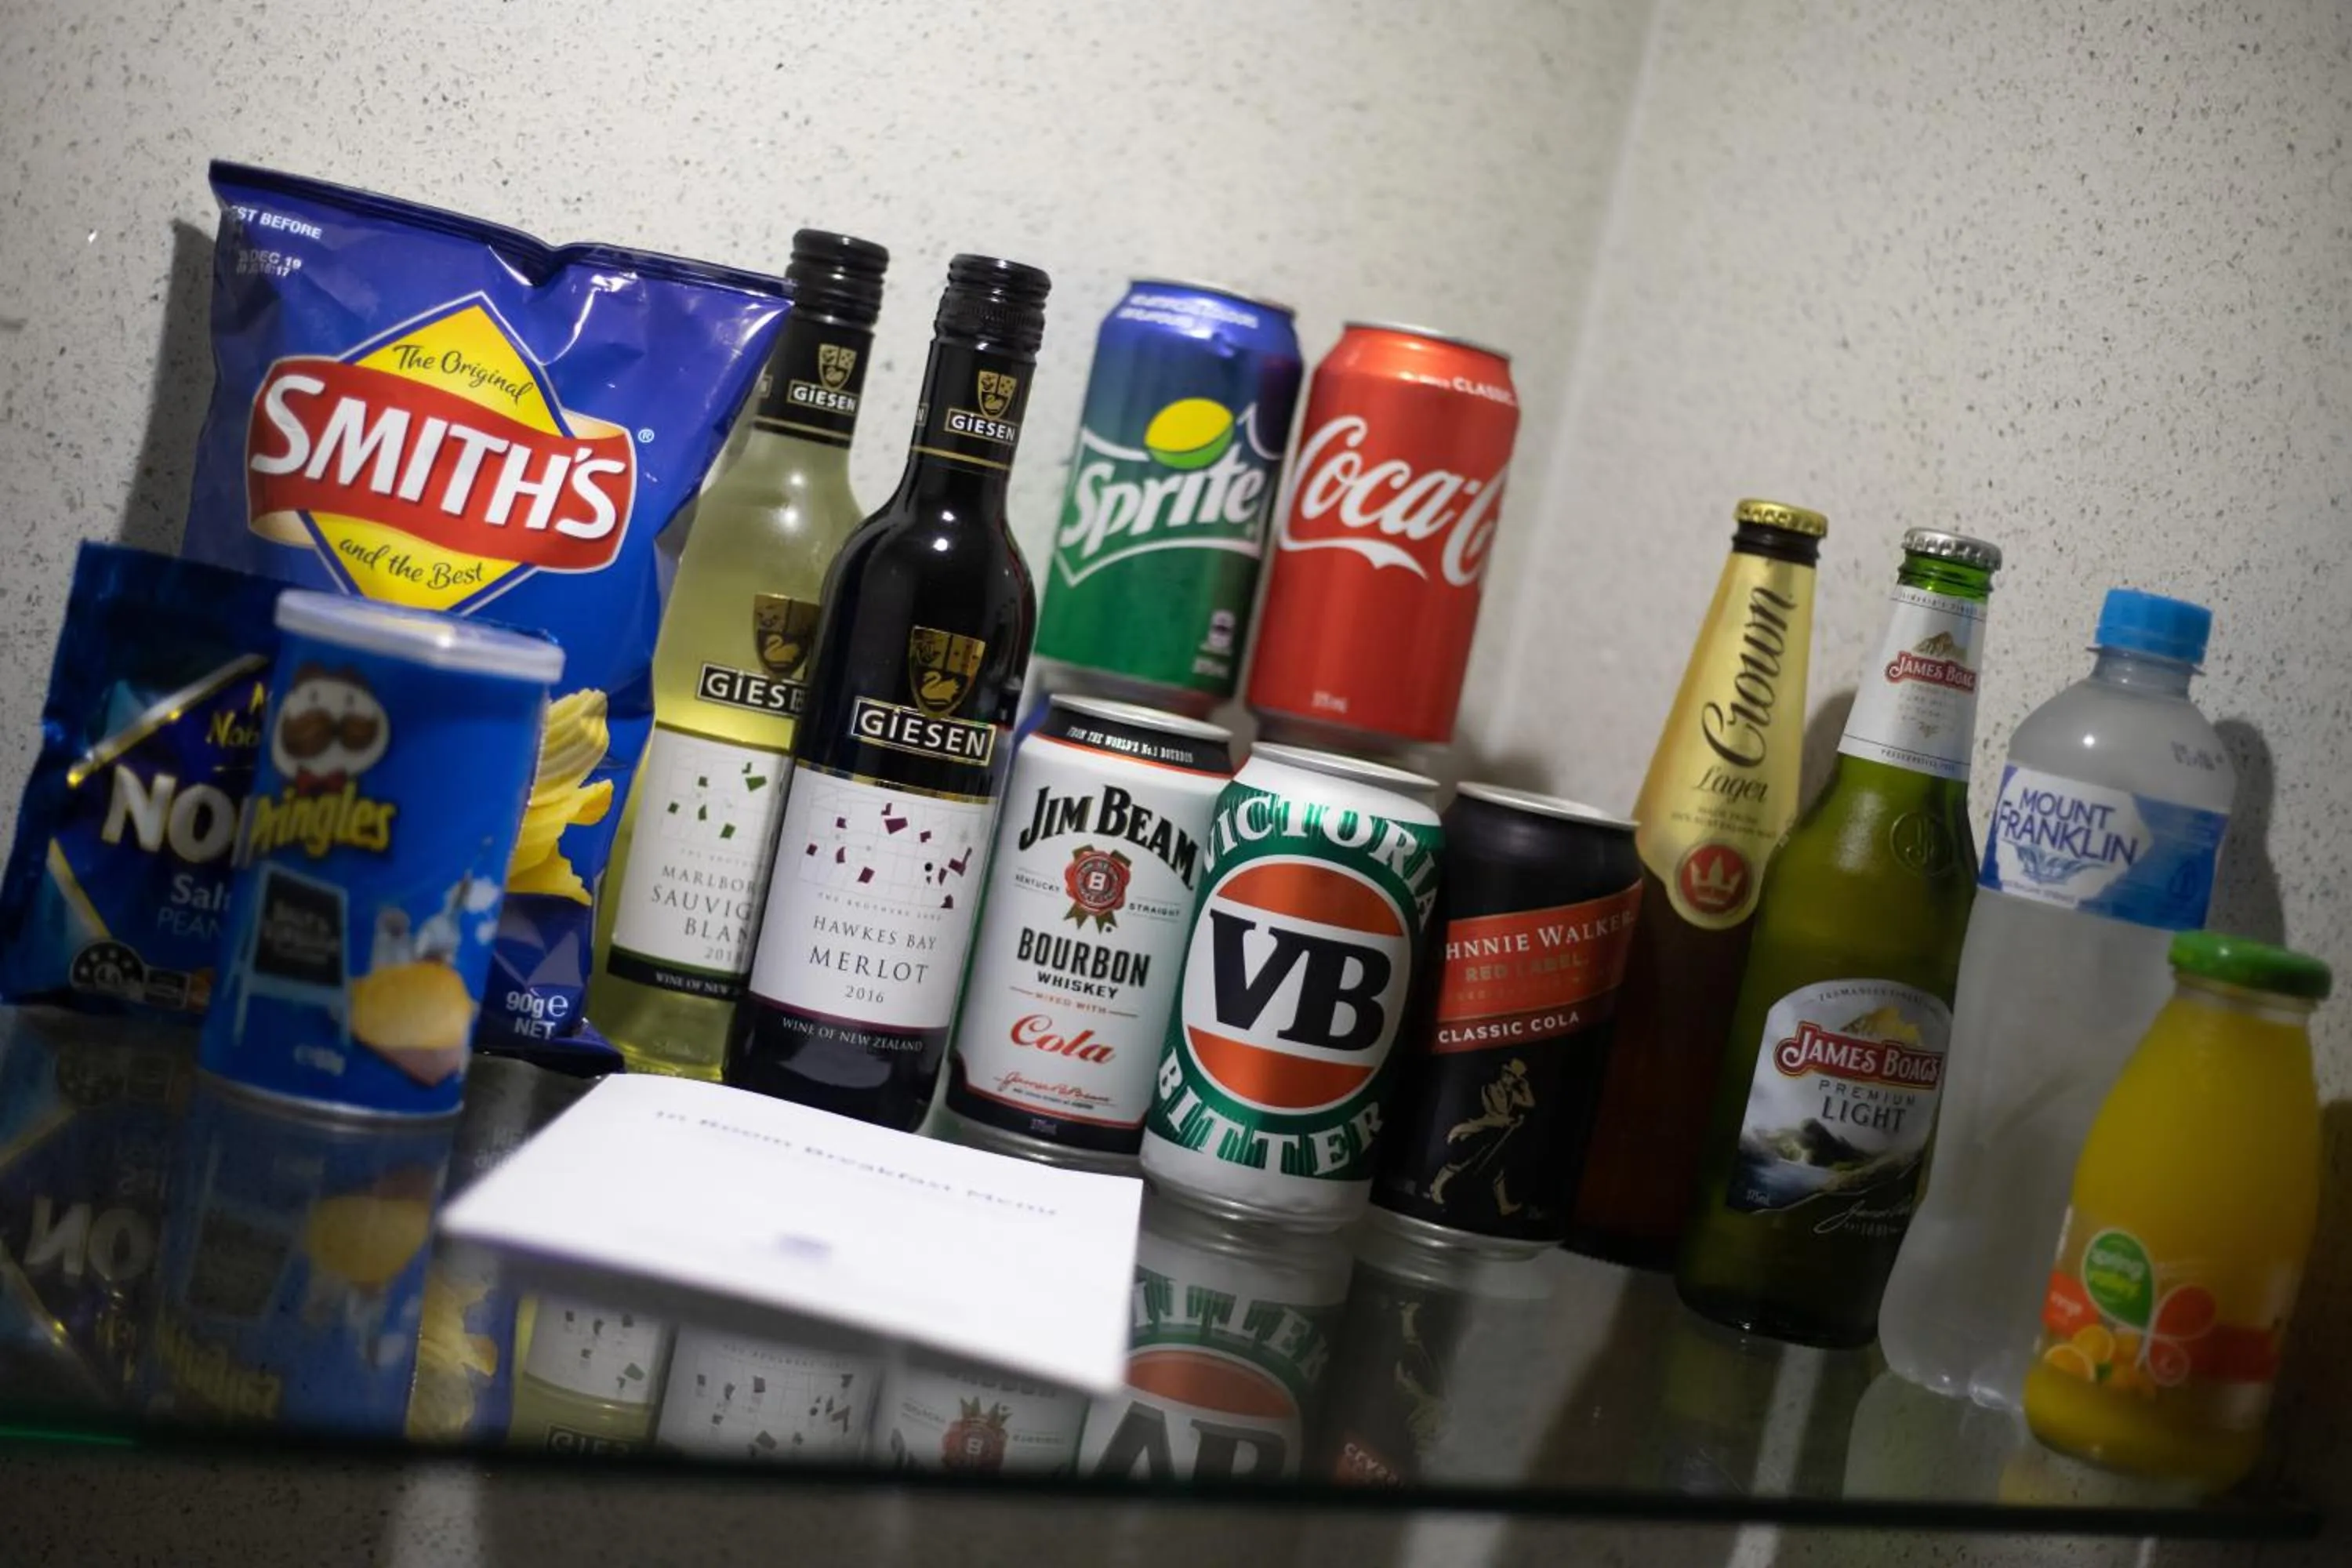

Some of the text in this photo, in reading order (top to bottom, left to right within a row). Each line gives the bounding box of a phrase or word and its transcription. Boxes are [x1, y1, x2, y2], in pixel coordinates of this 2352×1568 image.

[259, 212, 322, 239] BEFORE
[393, 344, 534, 405] The Original
[250, 374, 625, 539] SMITH'S
[1060, 444, 1265, 559] Sprite
[339, 539, 484, 590] and the Best
[1700, 586, 1799, 768] Crown
[1889, 655, 1944, 680] JAMES
[1691, 764, 1769, 804] Lager
[250, 782, 397, 857] Pringles
[2019, 786, 2117, 831] MOUNT
[1018, 784, 1202, 891] JIM BEAM
[1997, 800, 2139, 867] FRANKLIN
[1015, 873, 1181, 917] KENTUCKY STRAIGHT
[813, 914, 898, 946] HAWKES
[906, 934, 938, 951] BAY
[1537, 910, 1632, 948] WALKER
[809, 945, 929, 984] MERLOT
[1017, 927, 1152, 988] BOURBON
[844, 985, 885, 1004] 2016
[1036, 971, 1120, 1000] WHISKEY
[1209, 908, 1393, 1053] VB
[506, 991, 546, 1018] 90g
[1076, 1001, 1107, 1014] WITH
[514, 1017, 556, 1040] NET
[782, 1017, 924, 1051] WINE OF NEW ZEALAND
[1010, 1013, 1116, 1065] Cola
[1438, 1011, 1580, 1044] CLASSIC COLA
[1780, 1029, 1878, 1073] JAMES
[1158, 1049, 1386, 1176] BITTER
[1817, 1079, 1916, 1105] PREMIUM
[1821, 1094, 1907, 1134] LIGHT
